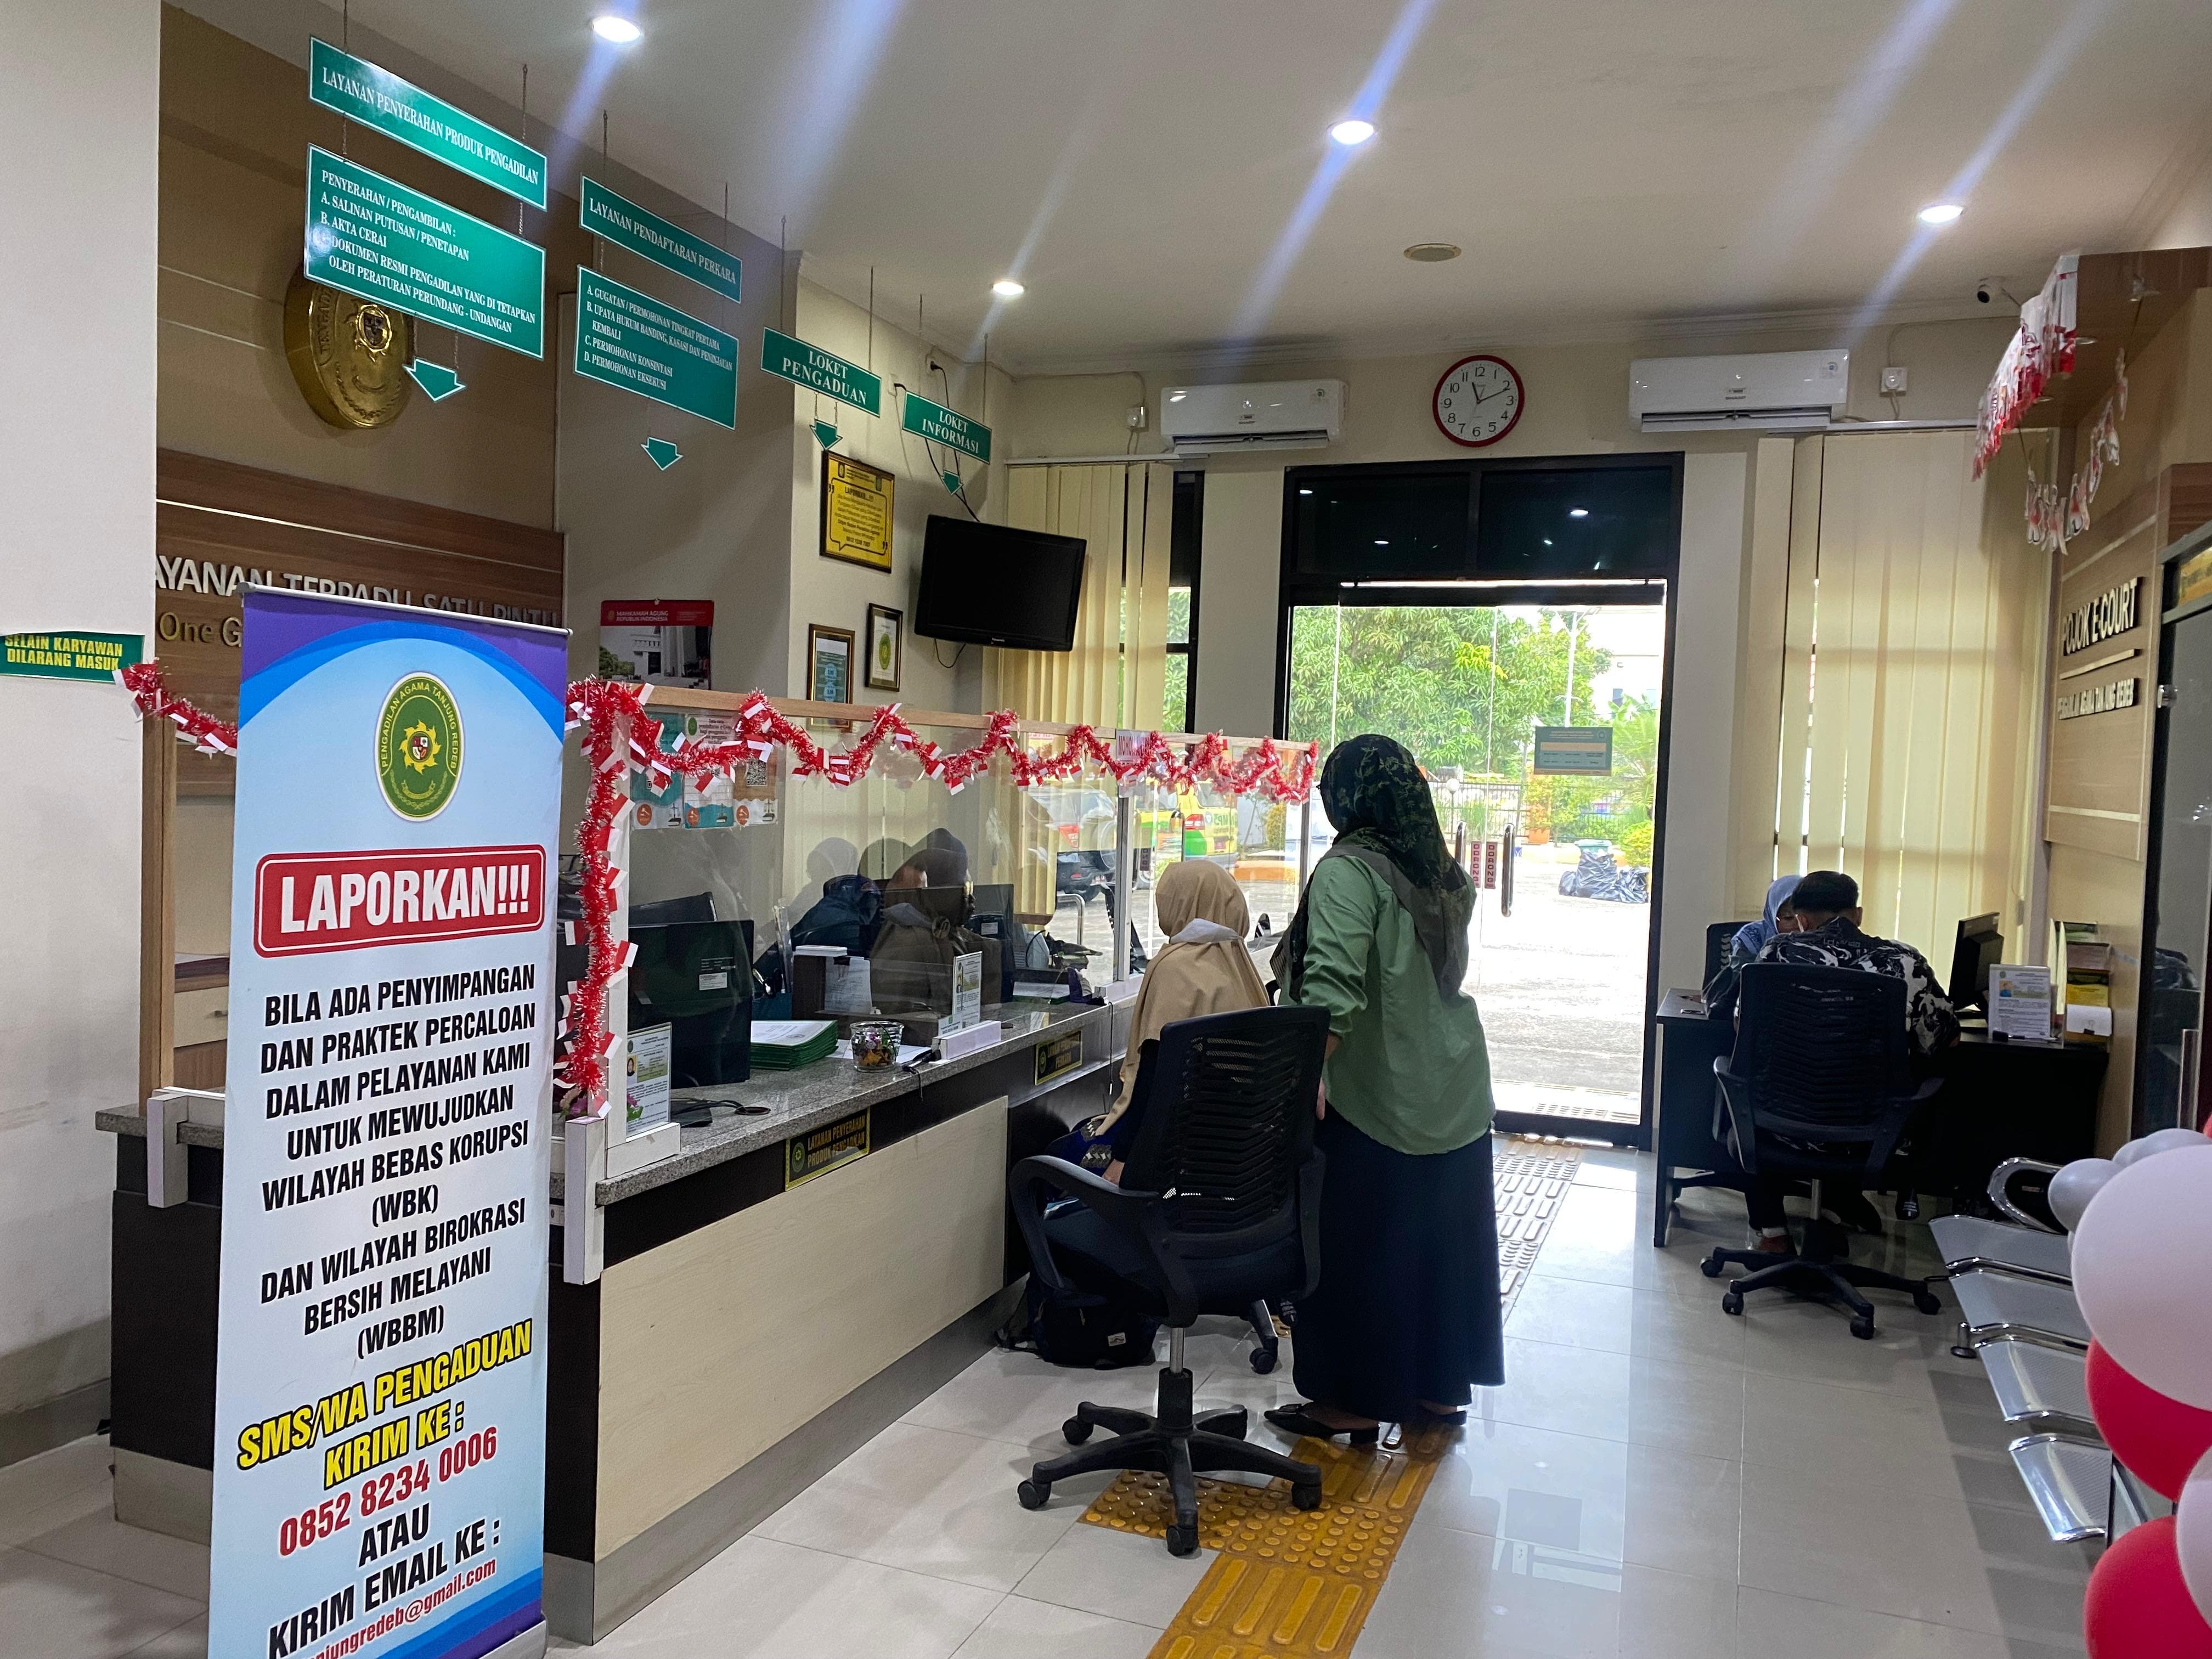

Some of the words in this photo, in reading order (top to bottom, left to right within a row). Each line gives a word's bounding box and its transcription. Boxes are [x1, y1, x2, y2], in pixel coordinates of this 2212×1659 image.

[323, 67, 375, 104] LAYANAN
[377, 94, 444, 138] PENYERAHAN
[445, 125, 483, 160] PRODUK
[484, 148, 539, 185] PENGADILAN
[321, 170, 385, 207] PENYERAHAN
[391, 200, 452, 235] PENGAMBILAN
[320, 211, 330, 225] B.
[331, 216, 357, 236] AKTA
[359, 227, 387, 247] CERAI
[321, 191, 330, 205] A.
[332, 195, 373, 222] SALINAN
[375, 212, 415, 239] PUTUSAN
[421, 231, 469, 261] PENETAPAN
[590, 198, 631, 232] LAYANAN
[634, 221, 697, 264] PENDAFTARAN
[698, 252, 736, 284] PERKARA
[329, 255, 355, 275] OLEH
[357, 264, 411, 296] PERATURAN
[413, 287, 464, 317] PERUNDANG
[470, 308, 512, 332] UNDANGAN
[332, 235, 379, 264] DOKUMEN
[380, 255, 408, 275] RESMI
[410, 267, 462, 297] PENGADILAN
[464, 288, 485, 306] YANG
[487, 294, 495, 309] DI
[496, 300, 535, 324] TETAPKAN
[586, 301, 593, 312] B.
[595, 304, 615, 321] UPAYA
[617, 314, 639, 331] HUKUM
[669, 336, 689, 352] KASASI
[689, 345, 700, 357] DAN
[592, 320, 621, 340] KEMBALI
[595, 287, 625, 309] GUGATAN
[629, 302, 670, 328] PERMOHONAN
[672, 321, 696, 340] TINGKAT
[696, 331, 720, 351] PERTAMA
[584, 351, 591, 362] D.
[592, 354, 636, 379] PERMOHONAN
[637, 371, 666, 390] EKSEKUSI
[585, 335, 591, 346] C.
[592, 337, 637, 363] PERMOHONAN
[638, 356, 673, 377] KONSINYASI
[809, 351, 848, 379] LOKET
[1462, 371, 1468, 382] 11
[1475, 366, 1485, 377] 12
[1494, 369, 1497, 379] 1
[782, 357, 867, 405] PENGADUAN
[1444, 398, 1452, 408] 9
[1449, 382, 1459, 393] 10
[1503, 380, 1510, 391] 2
[1506, 396, 1514, 405] 3
[922, 419, 979, 454] INFORMASI
[940, 410, 968, 434] LOKET
[1448, 413, 1455, 423] 8
[1458, 423, 1466, 433] 7
[1472, 426, 1481, 437] 6
[1488, 422, 1497, 432] 5
[1500, 410, 1508, 420] 4
[54, 637, 123, 657] KARYAWAN
[160, 612, 212, 642] One
[7, 648, 71, 667] DILARANG
[75, 654, 119, 670] MASUK
[382, 699, 400, 768] PENGADILAN
[400, 682, 431, 701] AGAMA
[432, 686, 456, 730] TANJUNG
[1487, 845, 1496, 883] DORONG
[280, 864, 530, 934] LAPORKAN!!!
[265, 991, 321, 1026] BILA
[329, 984, 371, 1019] ADA
[377, 964, 535, 1011] PENYIMPANGAN
[261, 1037, 313, 1074] DAN
[322, 1020, 420, 1064] PRAKTEK
[426, 1002, 536, 1045] PERCALOAN
[266, 1075, 351, 1119] DALAM
[357, 1052, 477, 1101] PELAYANAN
[482, 1042, 530, 1075] KAMI
[287, 1116, 362, 1160] UNTUK
[368, 1084, 514, 1142] MEWUJUDKAN
[262, 1159, 364, 1211] WILAYAH
[371, 1142, 443, 1184] BEBAS
[449, 1120, 528, 1165] KORUPSI
[372, 1184, 438, 1227] (WBK)
[261, 1261, 313, 1304] DAN
[321, 1230, 417, 1285] WILAYAH
[425, 1198, 526, 1253] BIROKRASI
[304, 1281, 382, 1335] BERSIH
[390, 1246, 491, 1305] MELAYANI
[358, 1304, 445, 1359] (WBBM)
[238, 1382, 368, 1470] SMS/WA
[374, 1318, 532, 1415] PENGADUAN
[324, 1415, 411, 1490] KIRIM
[417, 1399, 452, 1450] KE
[280, 1491, 351, 1557] 0852
[360, 1458, 430, 1517] 8234
[439, 1426, 497, 1482] 0006
[358, 1503, 430, 1567] ATAU
[268, 1585, 354, 1659] KIRIM
[365, 1539, 447, 1613] EMAIL
[455, 1519, 485, 1565] KE
